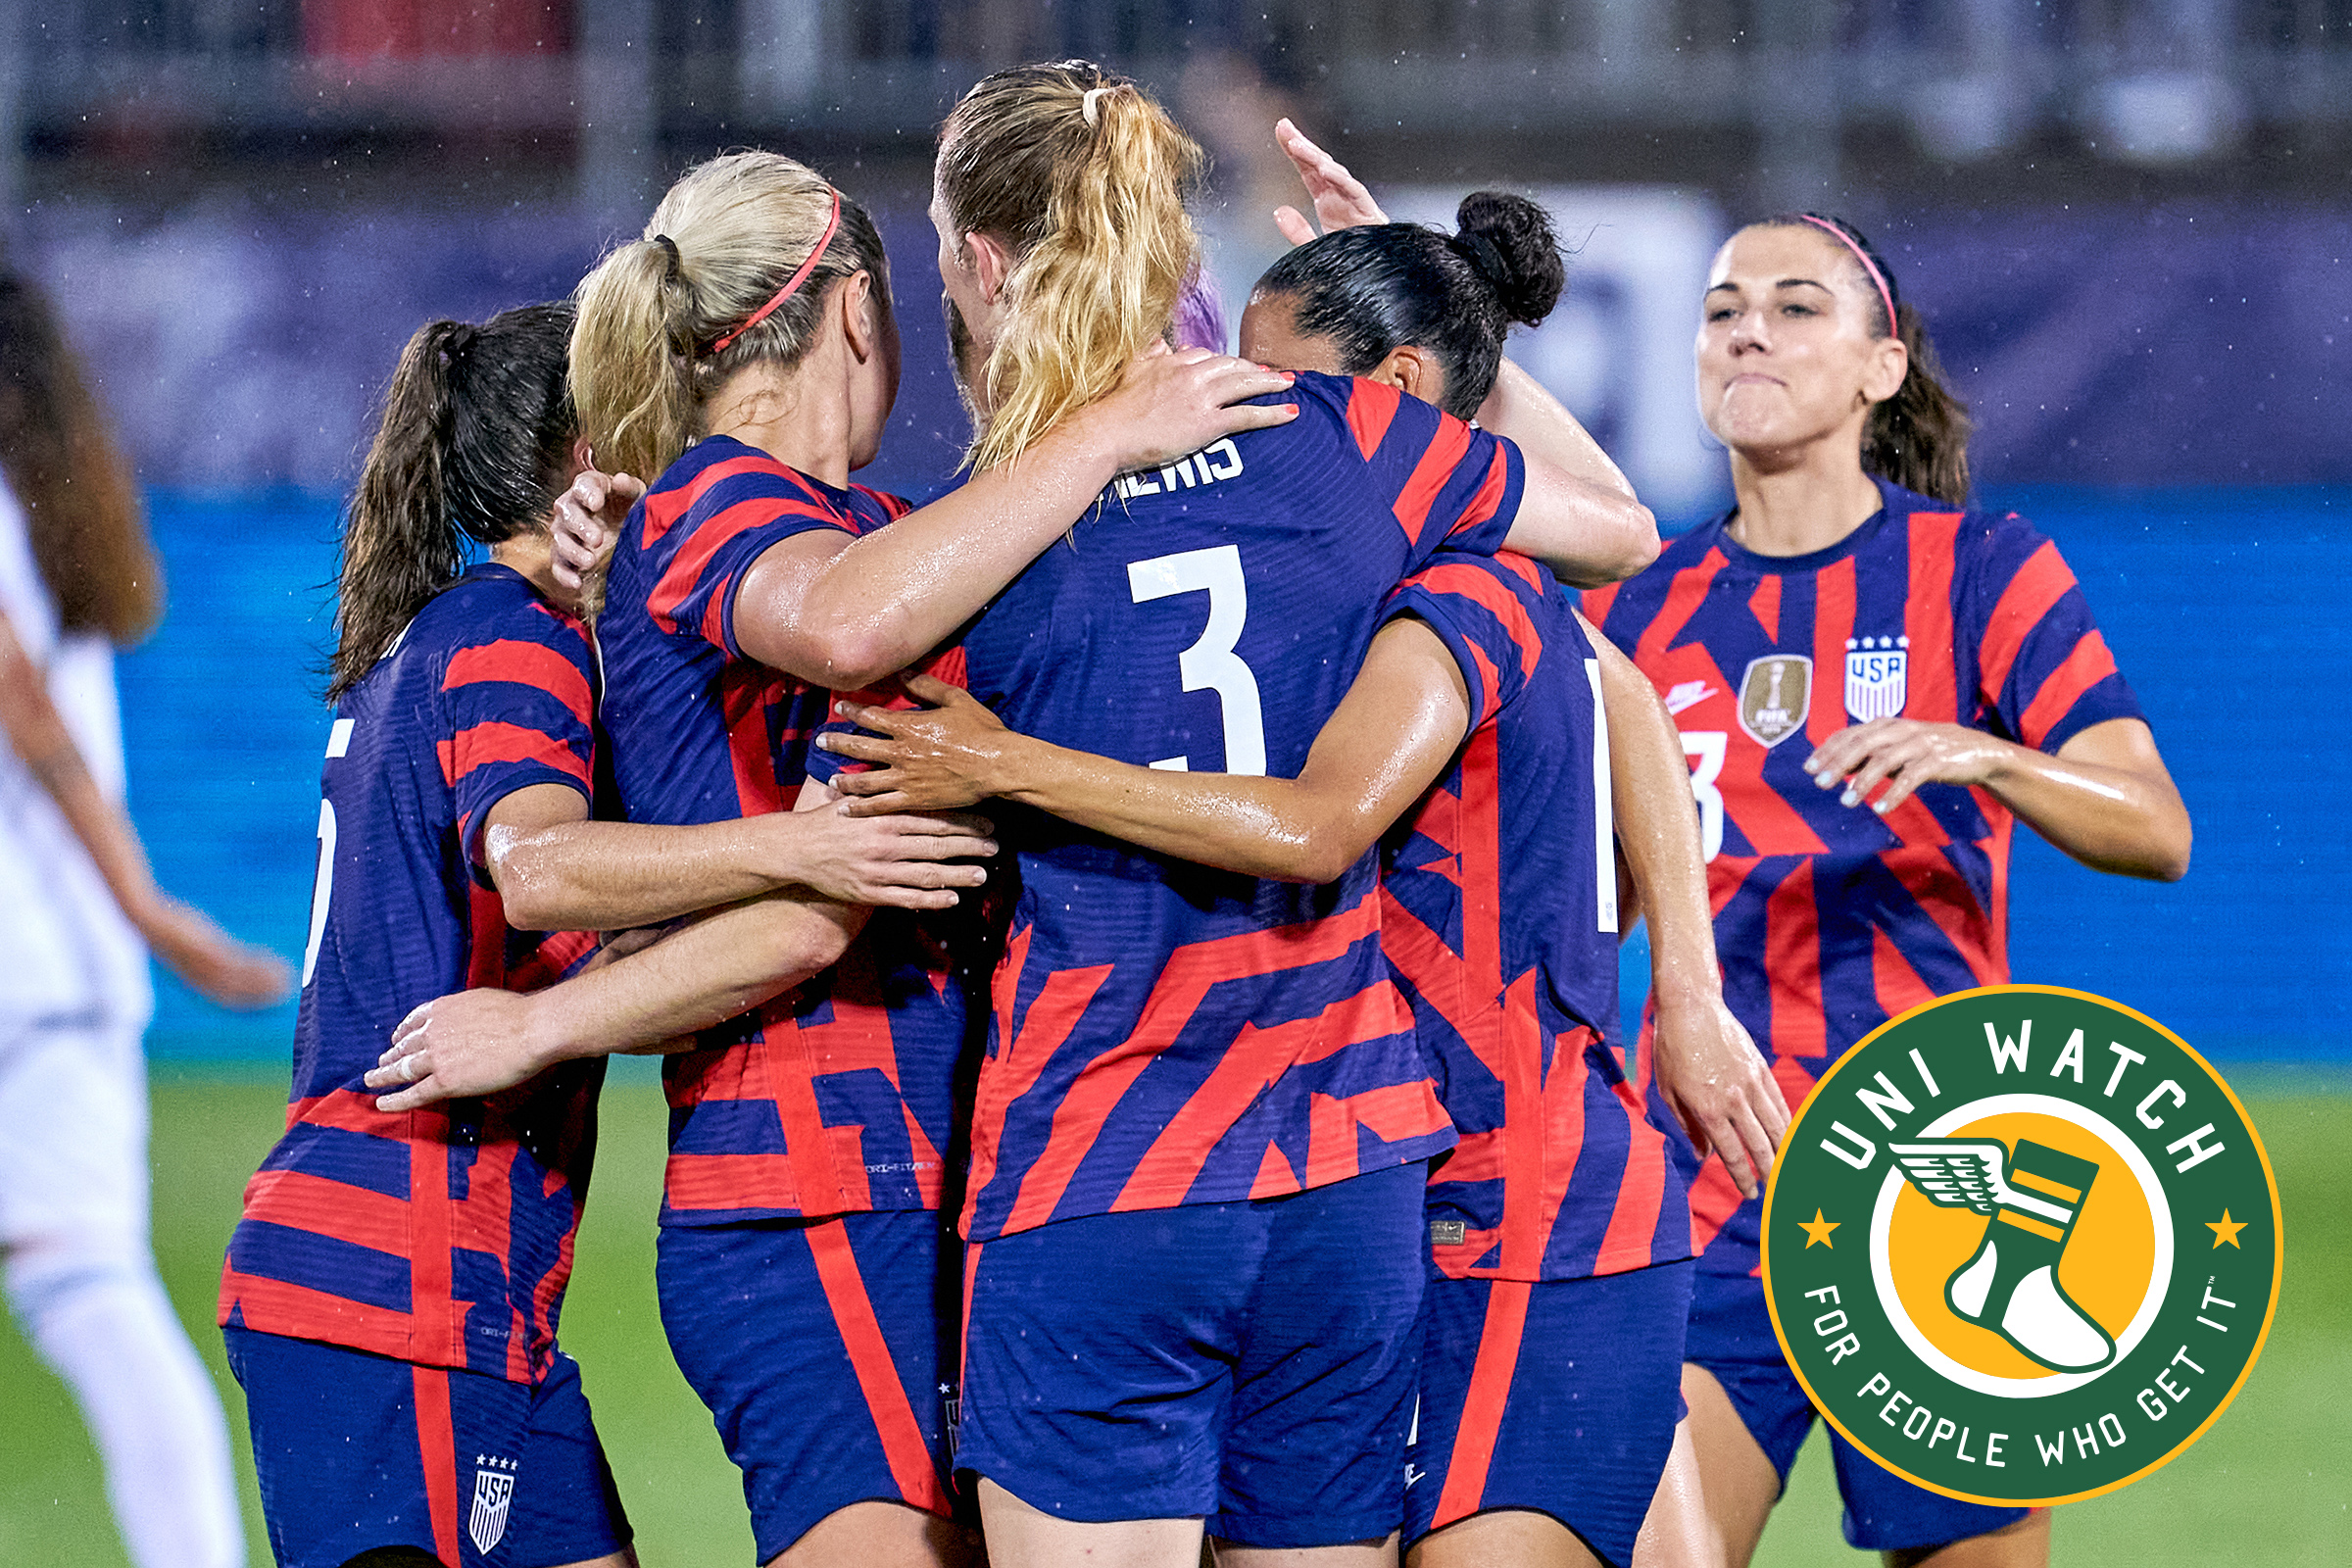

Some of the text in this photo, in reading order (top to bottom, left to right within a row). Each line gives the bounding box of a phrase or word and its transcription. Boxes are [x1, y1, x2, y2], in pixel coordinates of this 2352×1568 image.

[1127, 544, 1267, 776] 3
[1851, 657, 1901, 684] USA
[478, 1474, 511, 1507] USA
